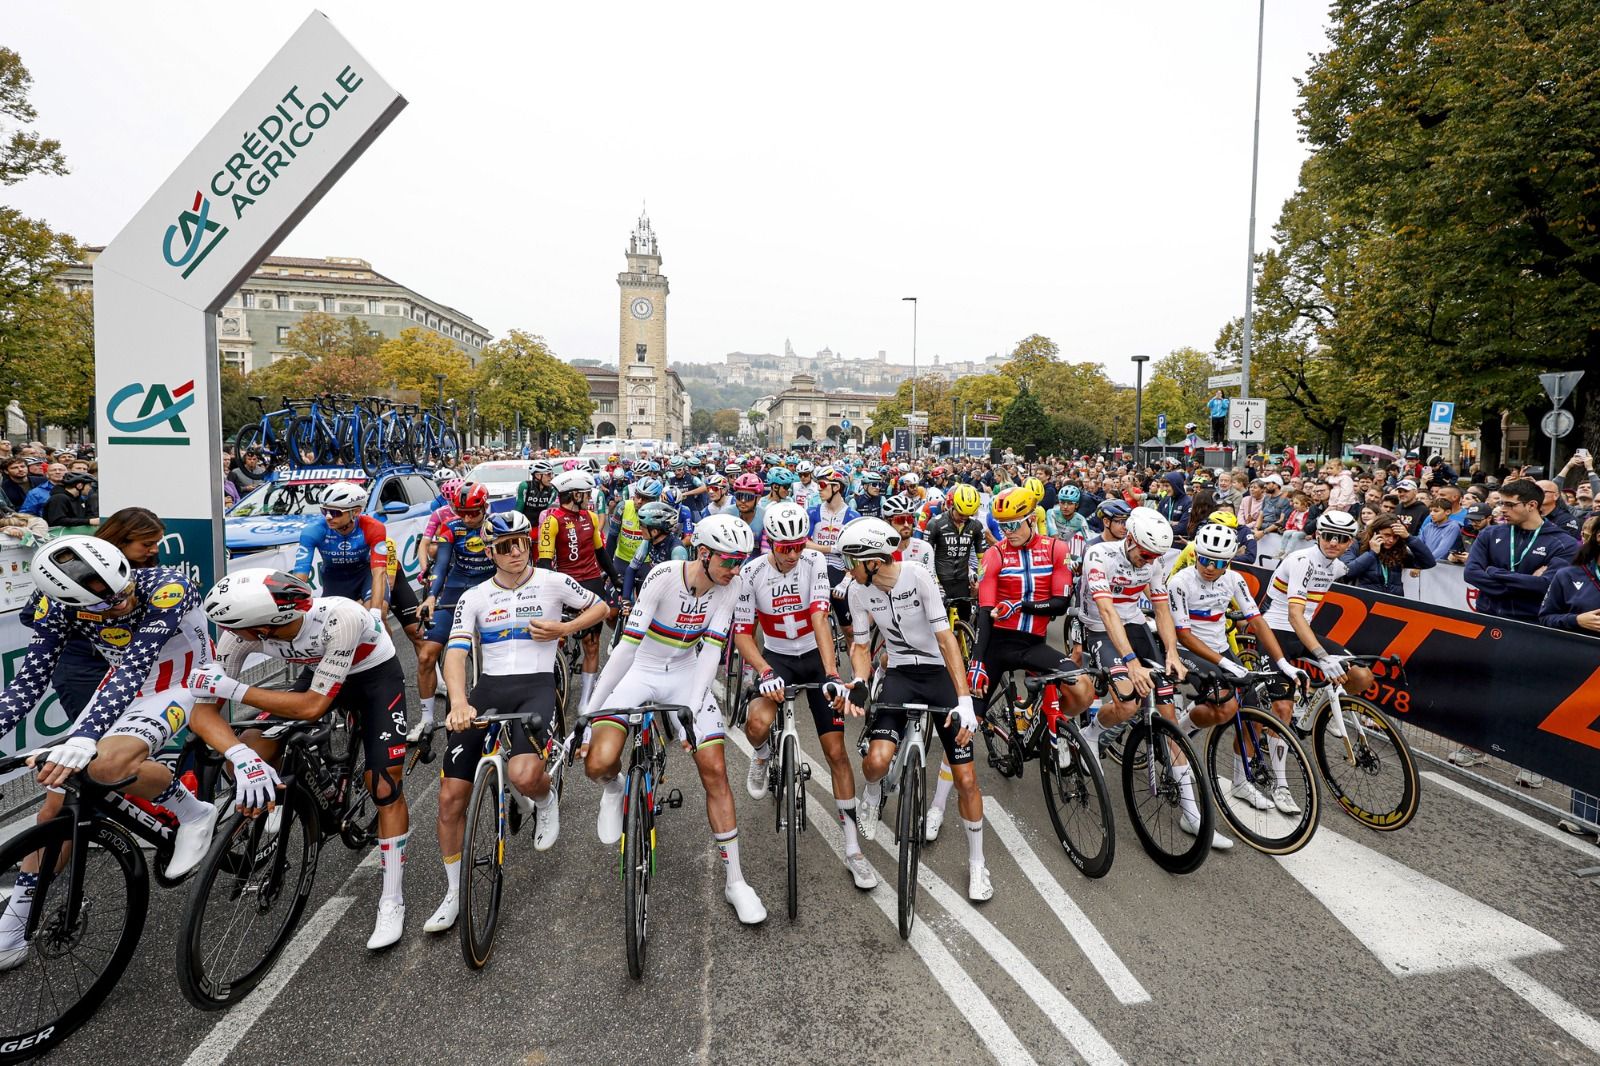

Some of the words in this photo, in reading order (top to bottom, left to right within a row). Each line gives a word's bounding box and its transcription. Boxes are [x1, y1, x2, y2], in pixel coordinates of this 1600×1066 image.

[210, 84, 306, 198] CRÉDIT
[230, 64, 364, 220] AGRICOLE
[1434, 403, 1450, 422] P
[1158, 414, 1165, 429] P
[278, 468, 369, 481] SHIMANO
[568, 528, 579, 562] Cofidis
[81, 542, 111, 568] TREK
[38, 565, 69, 591] TREK
[564, 577, 584, 597] BOSS
[771, 583, 800, 598] UAE
[516, 605, 543, 613] BORA
[680, 601, 709, 614] UAE
[772, 604, 803, 614] XRG
[774, 598, 801, 606] Emirates
[210, 604, 232, 619] MET
[454, 599, 466, 625] BOSS
[497, 613, 511, 622] Bull
[279, 648, 323, 659] UAE
[315, 669, 342, 680] Emirates
[202, 675, 213, 691] UAE
[243, 764, 263, 775] UAE
[304, 771, 329, 811] COLNAGO
[104, 790, 174, 840] TREK
[98, 829, 132, 854] AEOLUS
